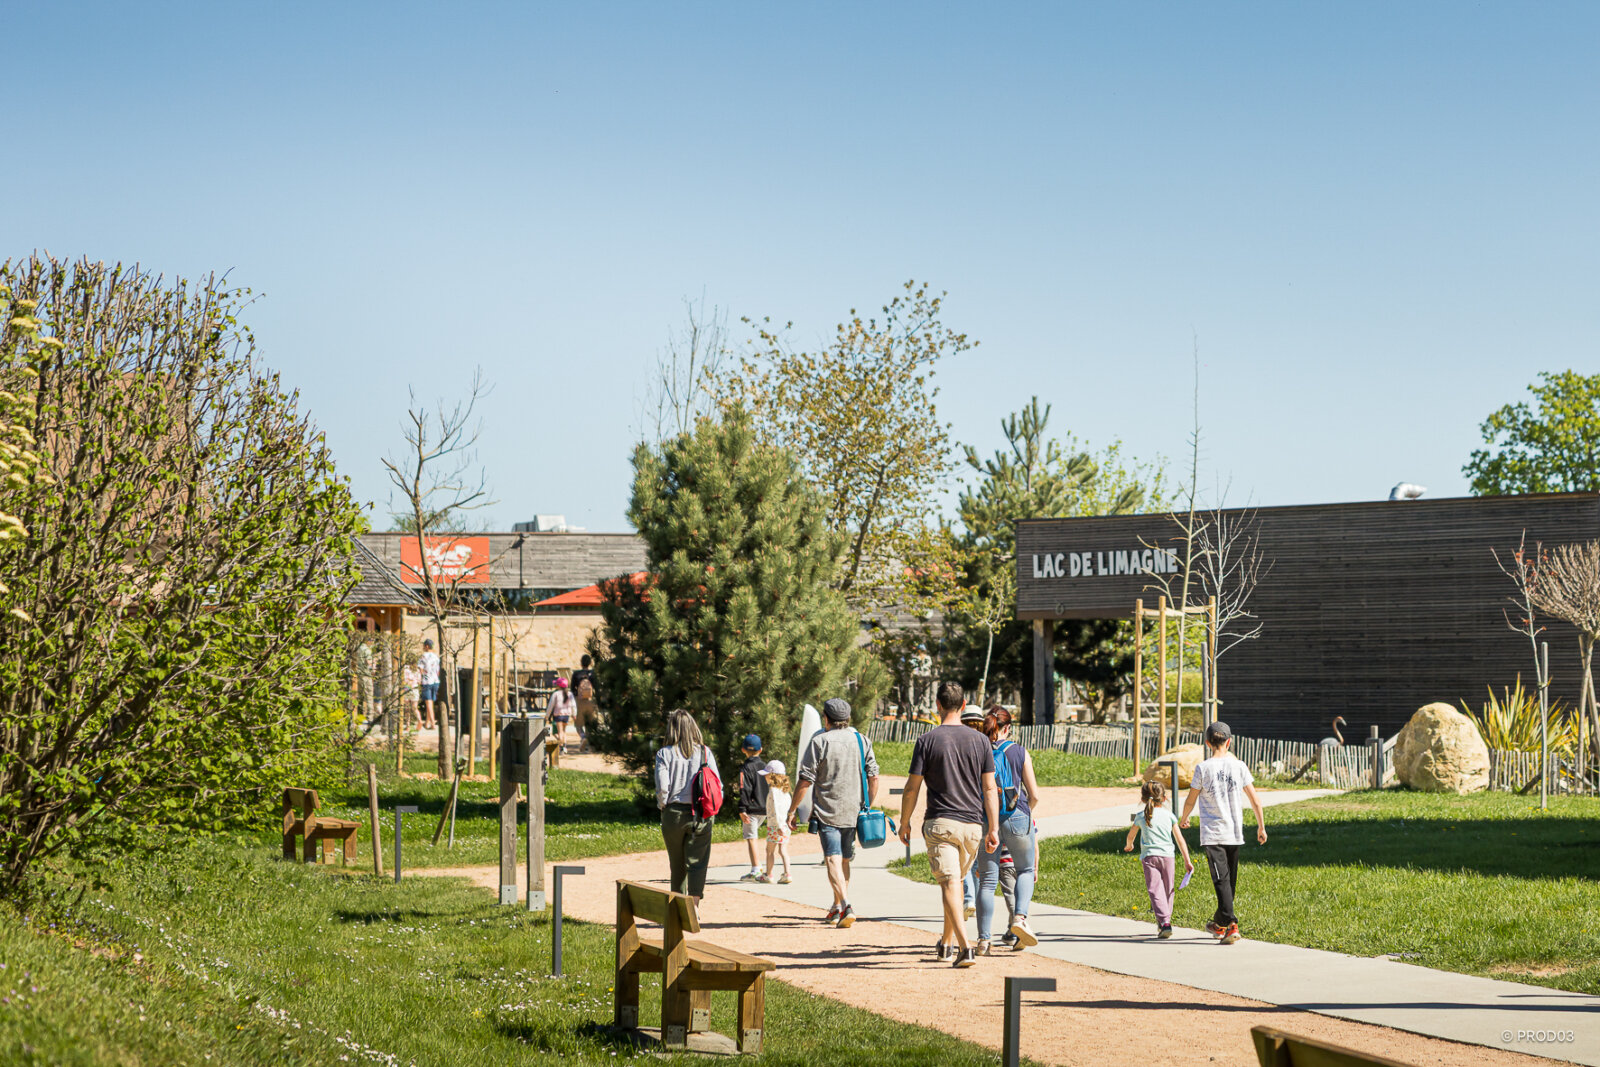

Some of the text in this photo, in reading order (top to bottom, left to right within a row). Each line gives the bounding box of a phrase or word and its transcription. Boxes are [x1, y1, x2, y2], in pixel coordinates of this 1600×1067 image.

[1032, 548, 1178, 578] LAC DE LIMAGNE
